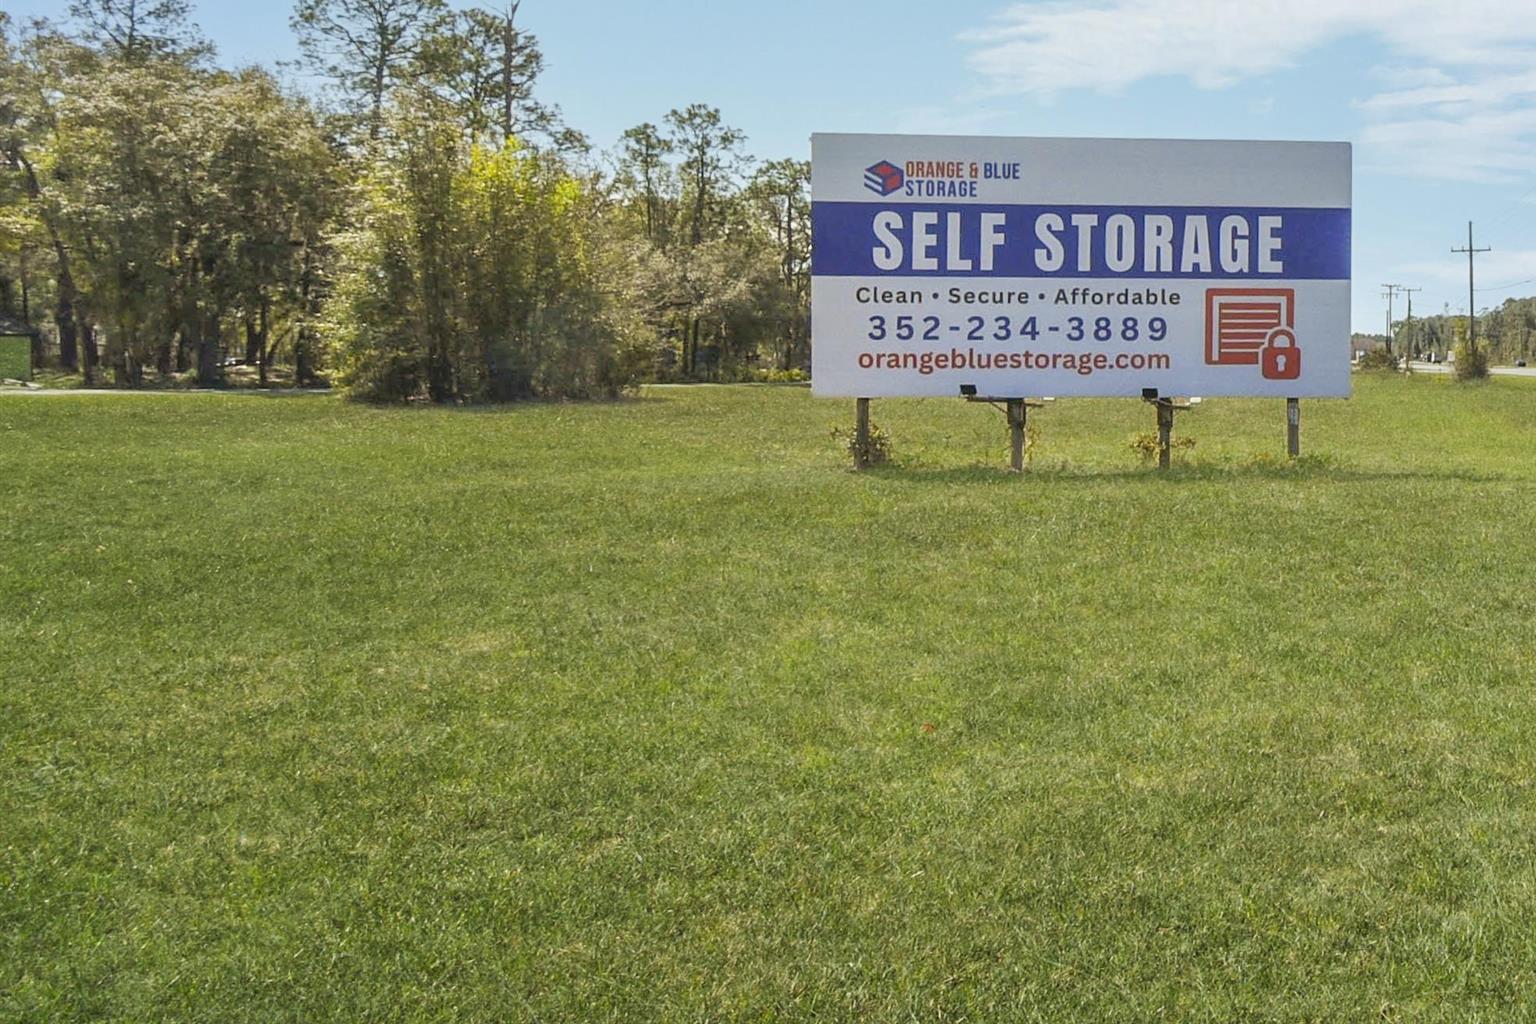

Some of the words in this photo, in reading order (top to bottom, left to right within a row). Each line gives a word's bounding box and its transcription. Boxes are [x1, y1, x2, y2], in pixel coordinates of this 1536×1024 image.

[905, 161, 964, 178] ORANGE
[969, 162, 979, 179] &
[983, 162, 1021, 180] BLUE
[905, 179, 978, 197] STORAGE
[872, 210, 1006, 271] SELF
[1034, 212, 1284, 274] STORAGE
[856, 286, 923, 304] Clean
[948, 287, 1030, 305] Secure
[1054, 288, 1181, 305] Affordable
[868, 315, 1168, 342] 352-234-3889
[858, 348, 1171, 375] orangebluestorage.com
